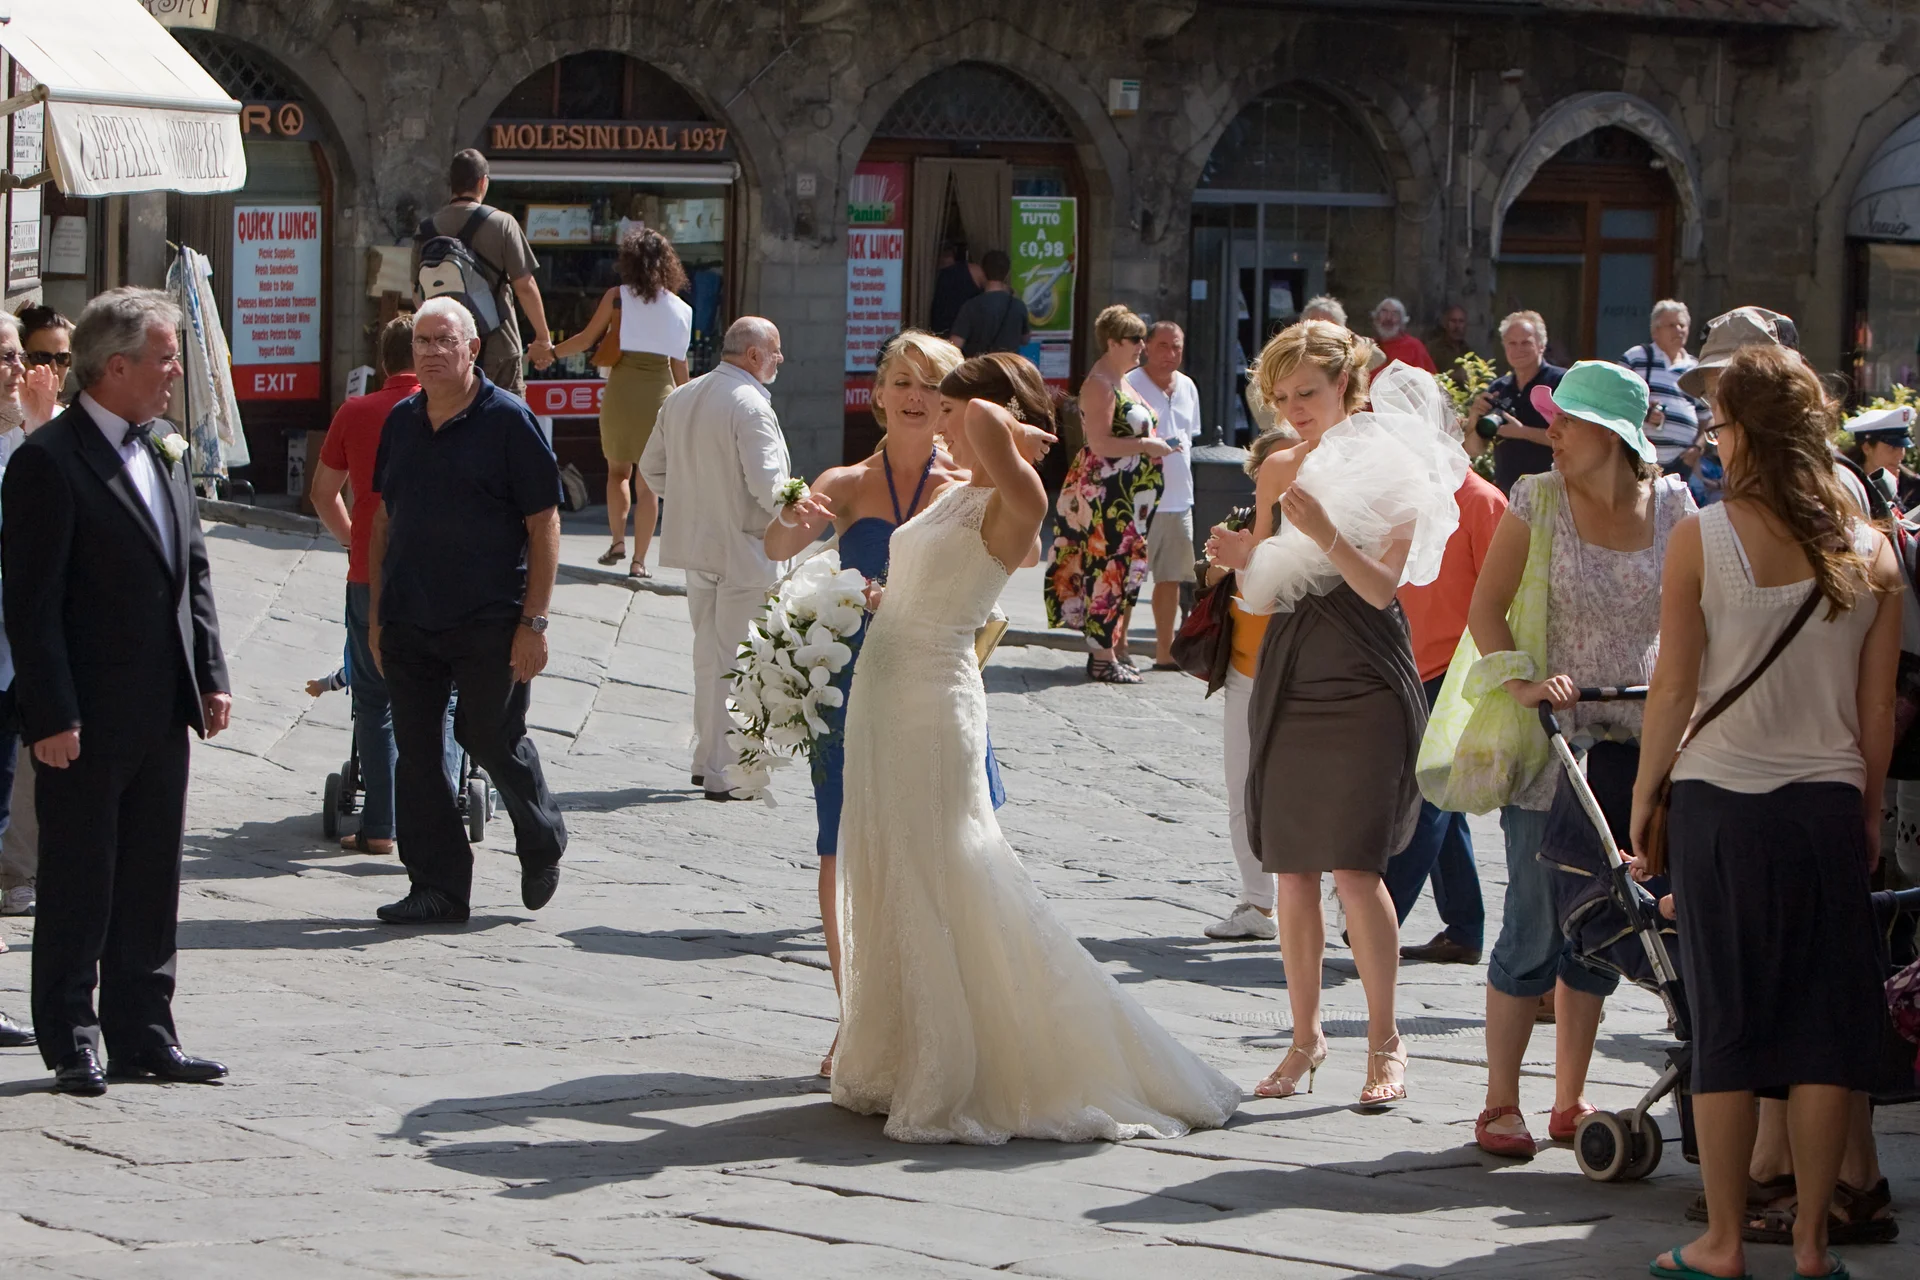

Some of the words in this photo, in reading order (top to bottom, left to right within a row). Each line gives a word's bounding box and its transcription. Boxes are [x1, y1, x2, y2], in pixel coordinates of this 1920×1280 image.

[495, 124, 621, 150] MOLESINI
[625, 126, 677, 151] DAL
[680, 128, 728, 151] 1937
[76, 114, 163, 182] CAPPELLI
[1021, 212, 1060, 225] TUTTO
[238, 211, 275, 244] QUICK
[278, 211, 317, 240] LUNCH
[1036, 228, 1047, 240] A
[870, 233, 903, 259] LUNCH
[1019, 241, 1064, 260] €0,98
[258, 247, 273, 259] Picnic
[274, 247, 295, 260] Supplies
[255, 264, 268, 275] Fresh
[269, 264, 299, 275] Sandwiches
[258, 280, 272, 292] Made
[273, 281, 279, 291] to
[280, 280, 294, 291] Order
[237, 297, 257, 308] Cheeses
[258, 297, 273, 308] Meats
[274, 296, 290, 308] Salads
[292, 296, 316, 307] Tomatoes
[242, 313, 253, 324] Cold
[254, 313, 269, 324] Drinks
[298, 312, 310, 323] Wine
[288, 329, 301, 340] Chips
[258, 346, 274, 359] Yogurt
[276, 345, 295, 356] Cookies
[254, 373, 297, 392] EXIT
[845, 388, 872, 405] NTR
